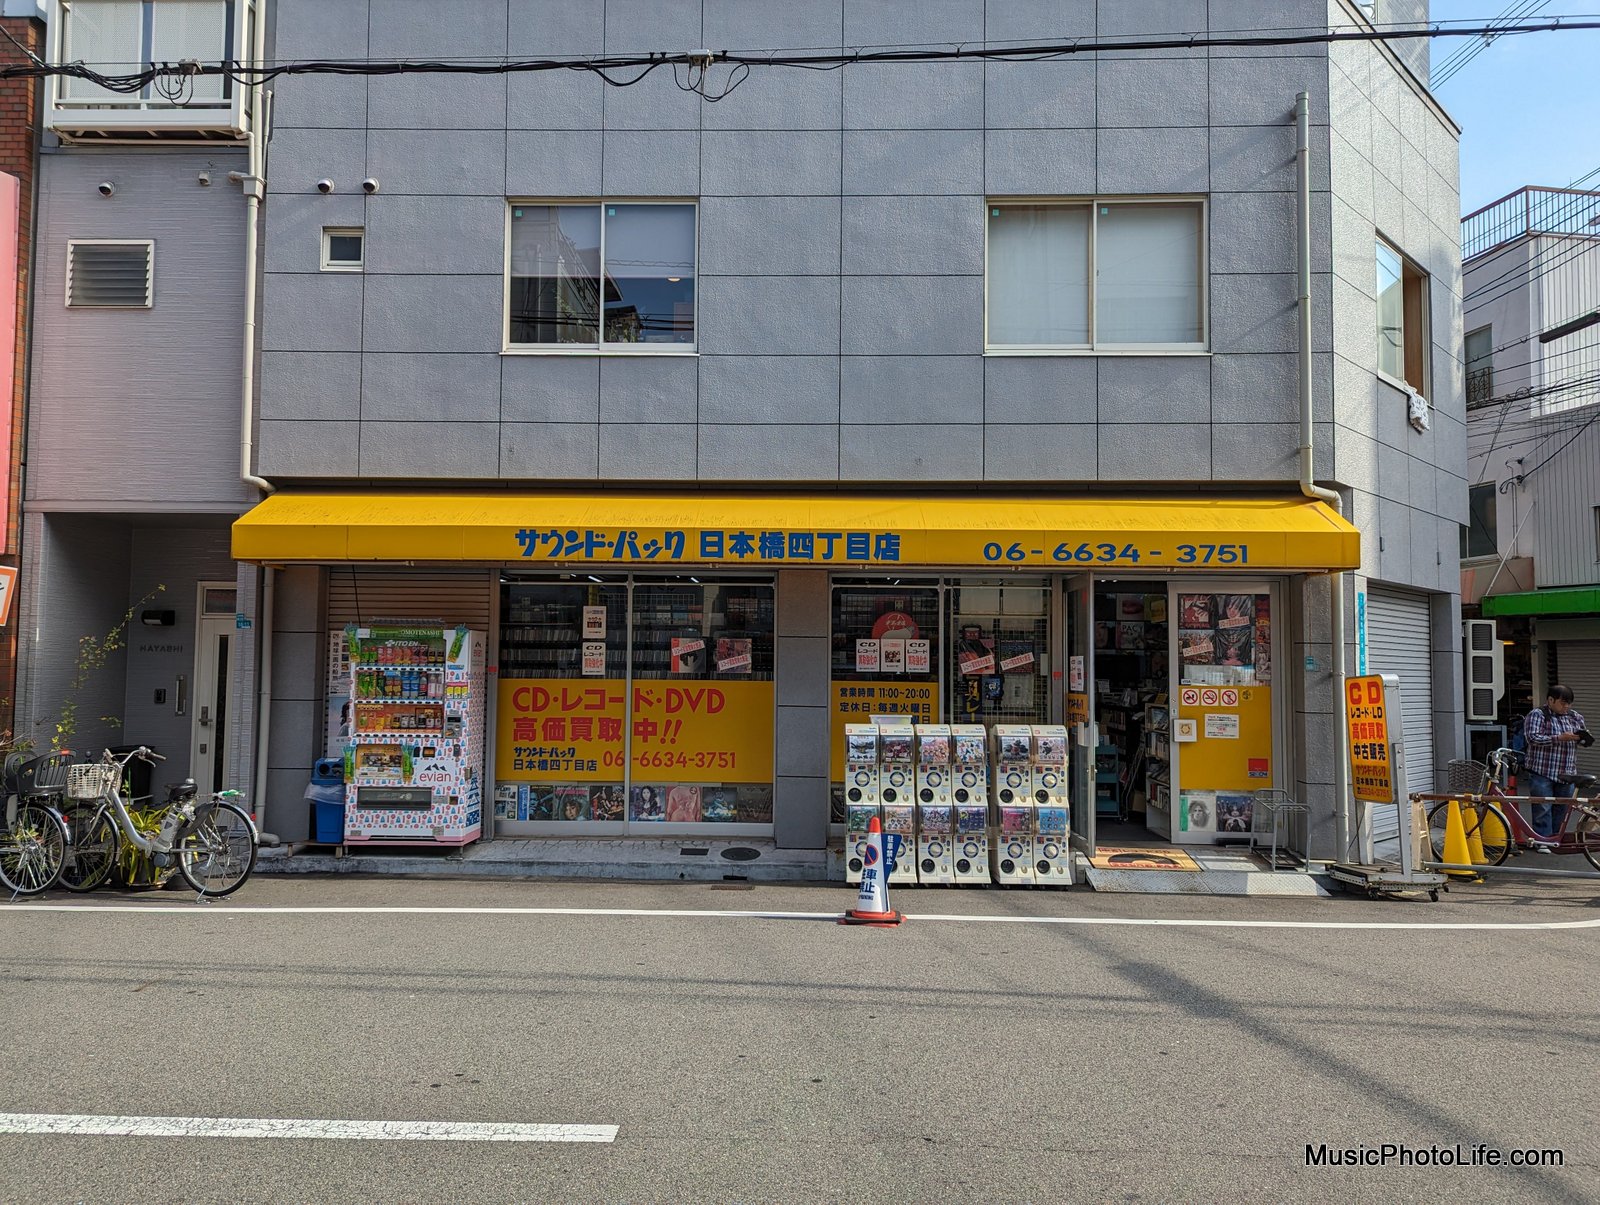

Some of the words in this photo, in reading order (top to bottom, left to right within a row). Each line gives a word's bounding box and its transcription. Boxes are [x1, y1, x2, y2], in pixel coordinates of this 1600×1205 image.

[700, 530, 900, 561] 日本橋四丁目店
[139, 644, 183, 653] HAYASHI
[839, 687, 875, 698] 営業時間
[1352, 722, 1384, 740] 高価買取
[1353, 742, 1386, 761] 中古販売
[513, 759, 598, 772] 日本橋四丁目店
[419, 772, 451, 782] evian
